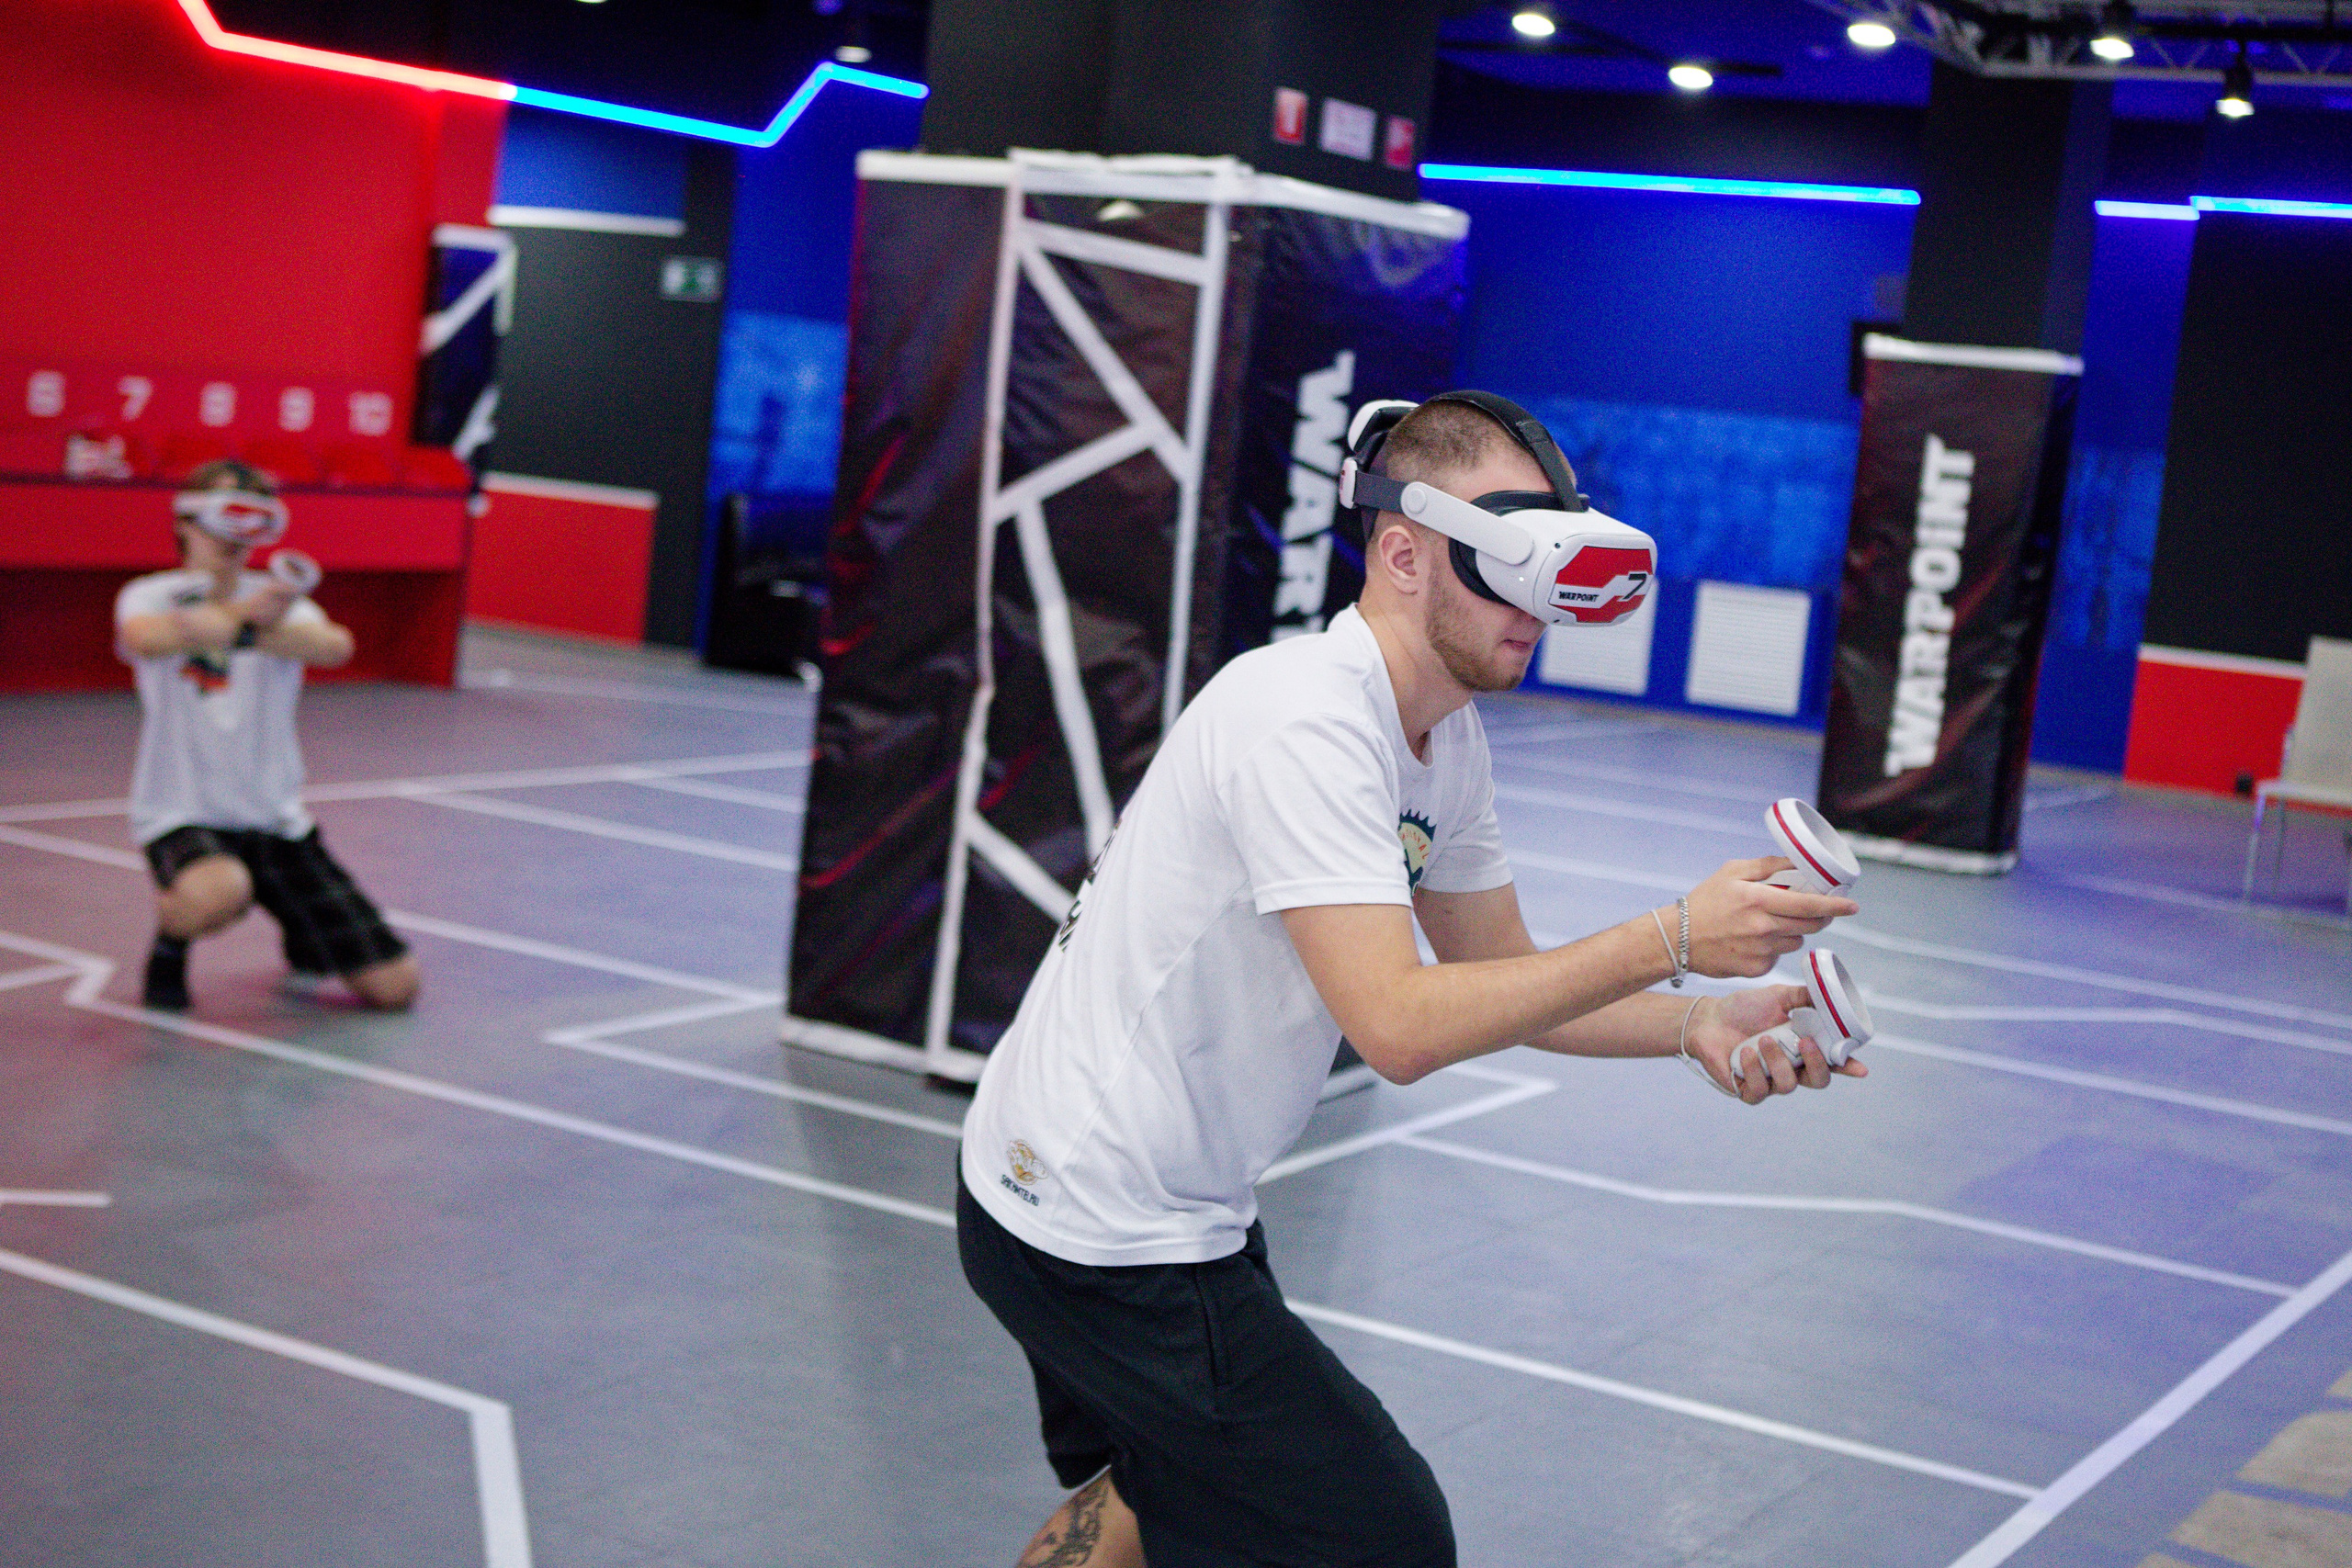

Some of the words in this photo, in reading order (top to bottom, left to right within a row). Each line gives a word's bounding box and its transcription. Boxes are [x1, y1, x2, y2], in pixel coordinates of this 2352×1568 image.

[118, 376, 153, 421] 7
[348, 391, 393, 436] 10
[1270, 349, 1355, 645] WAR
[1558, 591, 1600, 603] WARPOINT
[1623, 572, 1647, 601] 7
[1883, 433, 1975, 777] WARPOINT
